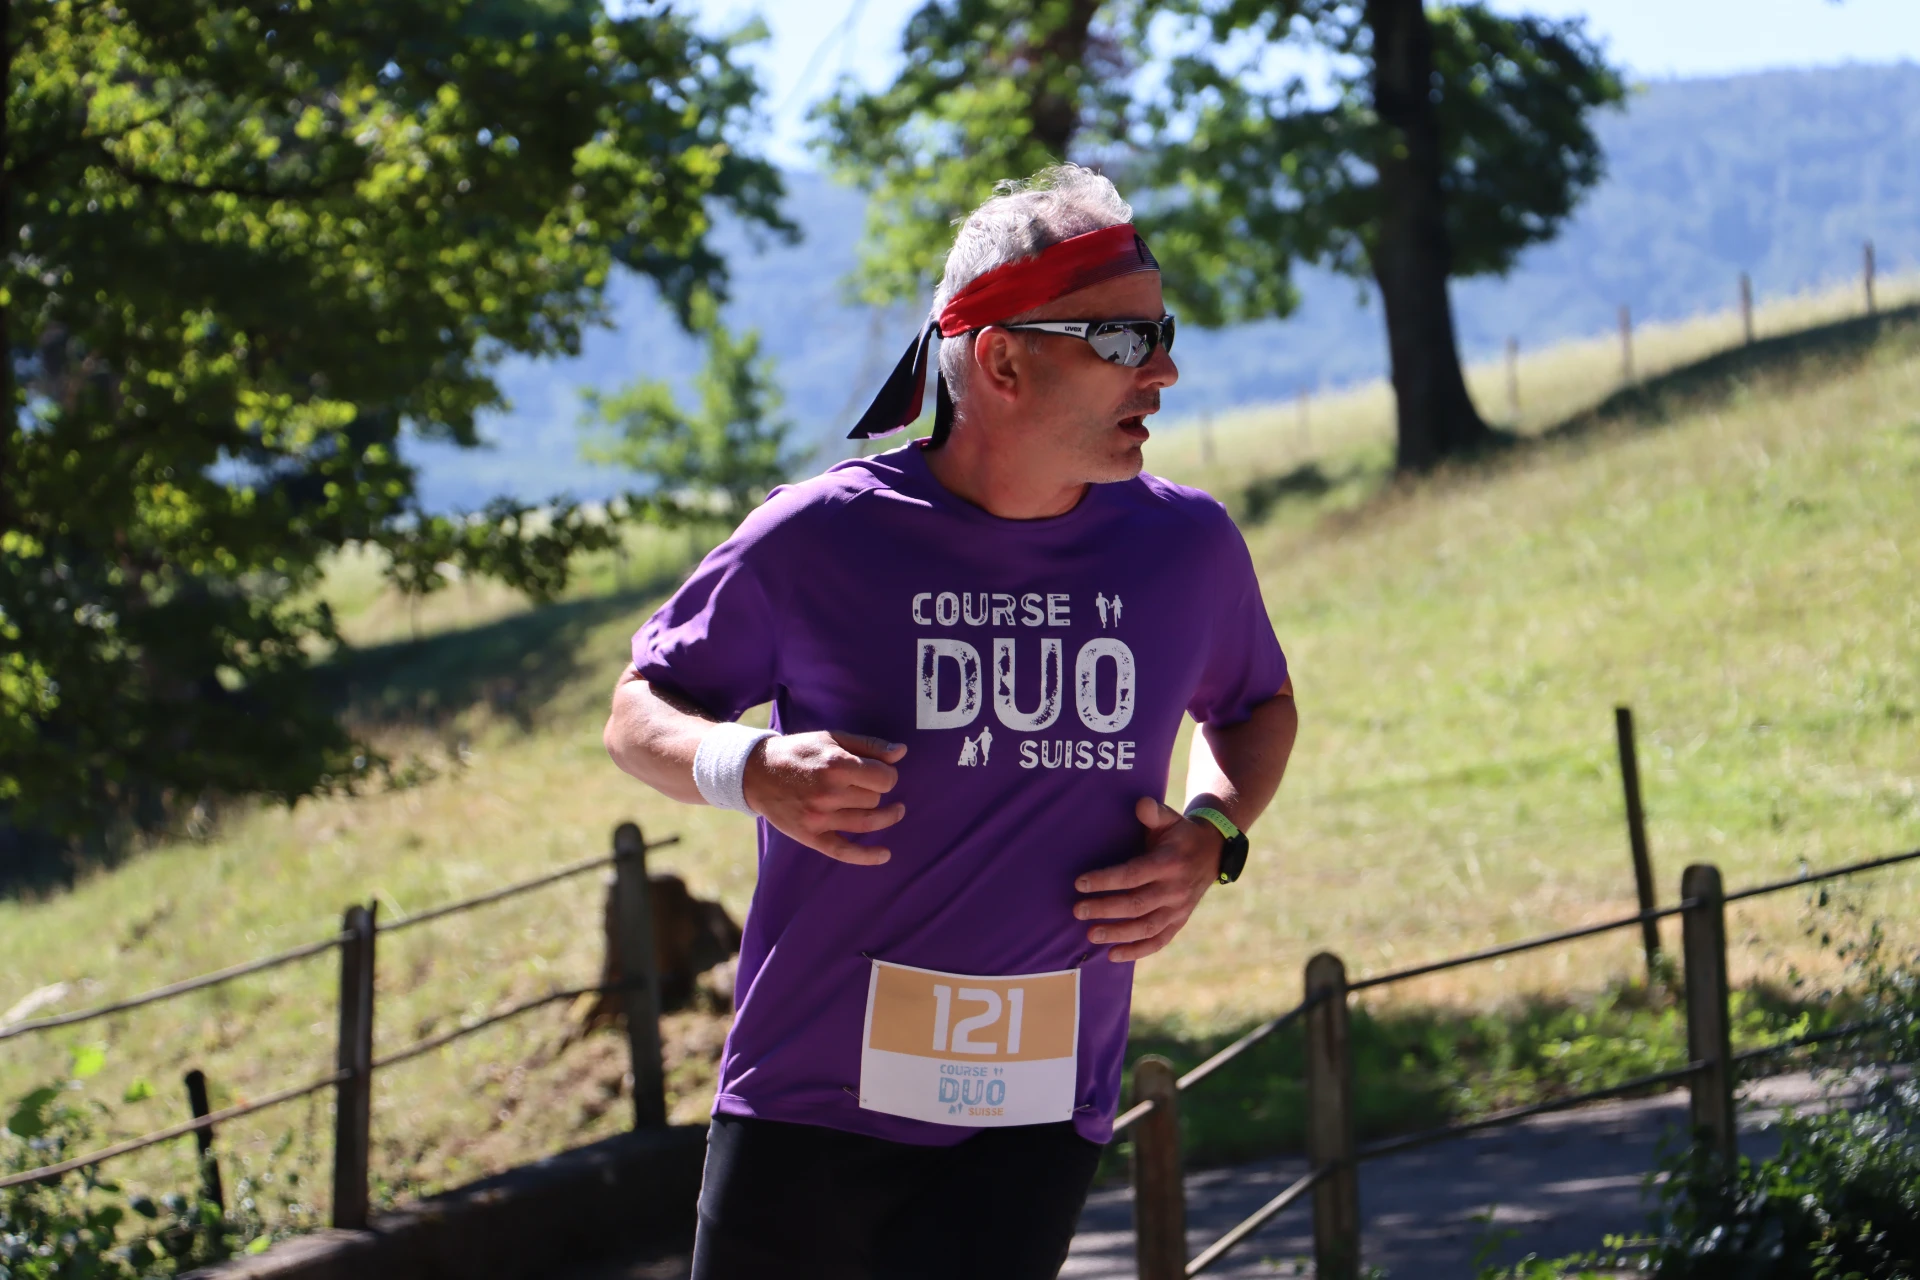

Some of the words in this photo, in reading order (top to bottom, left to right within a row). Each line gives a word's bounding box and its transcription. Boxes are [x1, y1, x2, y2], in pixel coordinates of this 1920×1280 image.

[1064, 325, 1082, 333] uvex
[912, 591, 1070, 626] COURSE
[916, 637, 1136, 734] DUO
[1019, 740, 1136, 770] SUISSE
[932, 984, 1024, 1055] 121
[940, 1064, 988, 1077] COURSE
[938, 1076, 1006, 1107] DUO
[968, 1107, 1005, 1117] SUISSE
